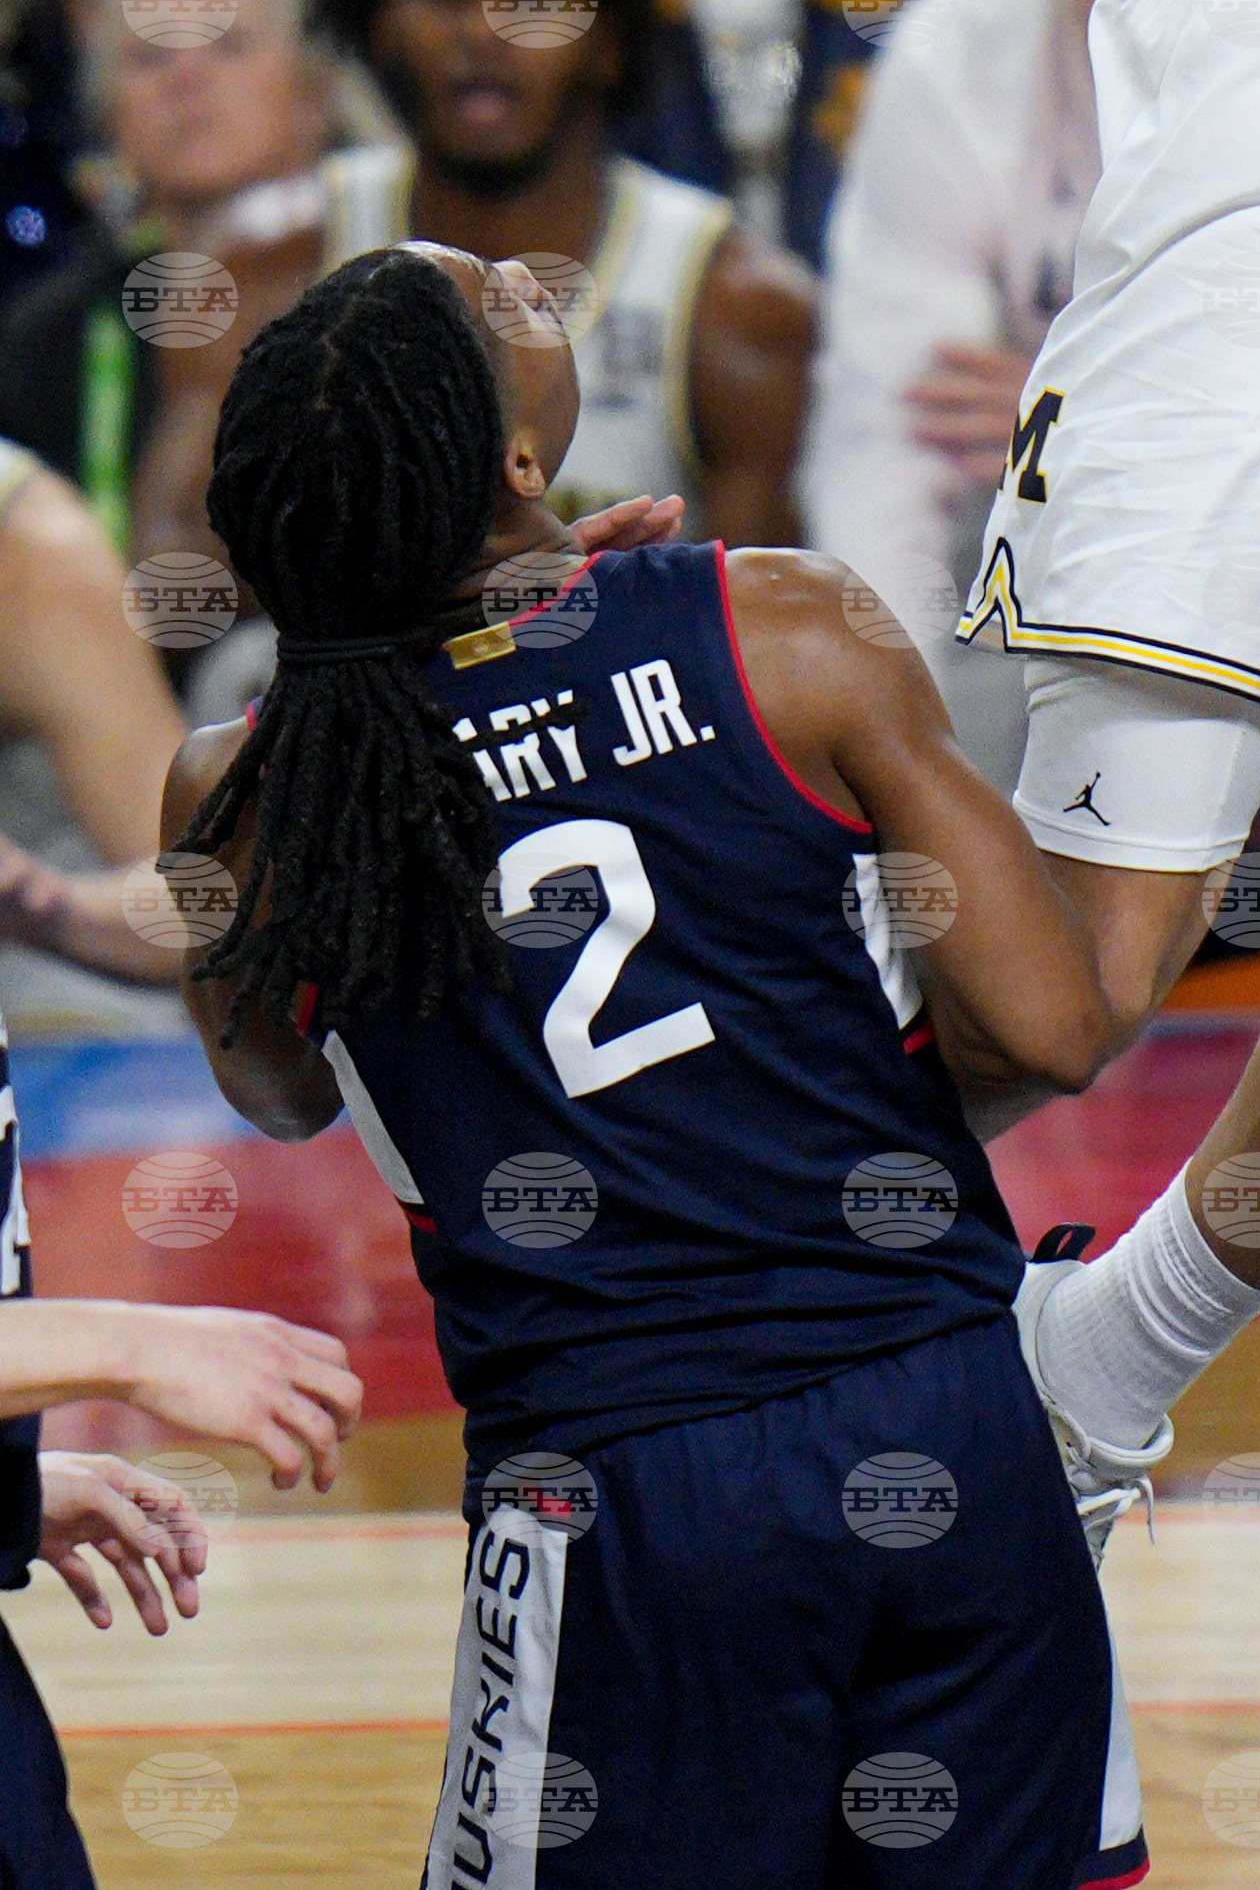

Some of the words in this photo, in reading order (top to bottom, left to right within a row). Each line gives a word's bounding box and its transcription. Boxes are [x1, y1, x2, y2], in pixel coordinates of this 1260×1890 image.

[1000, 386, 1067, 505] M
[611, 659, 716, 767] JR.
[498, 818, 716, 1099] 2
[452, 1528, 530, 1890] USKIES
